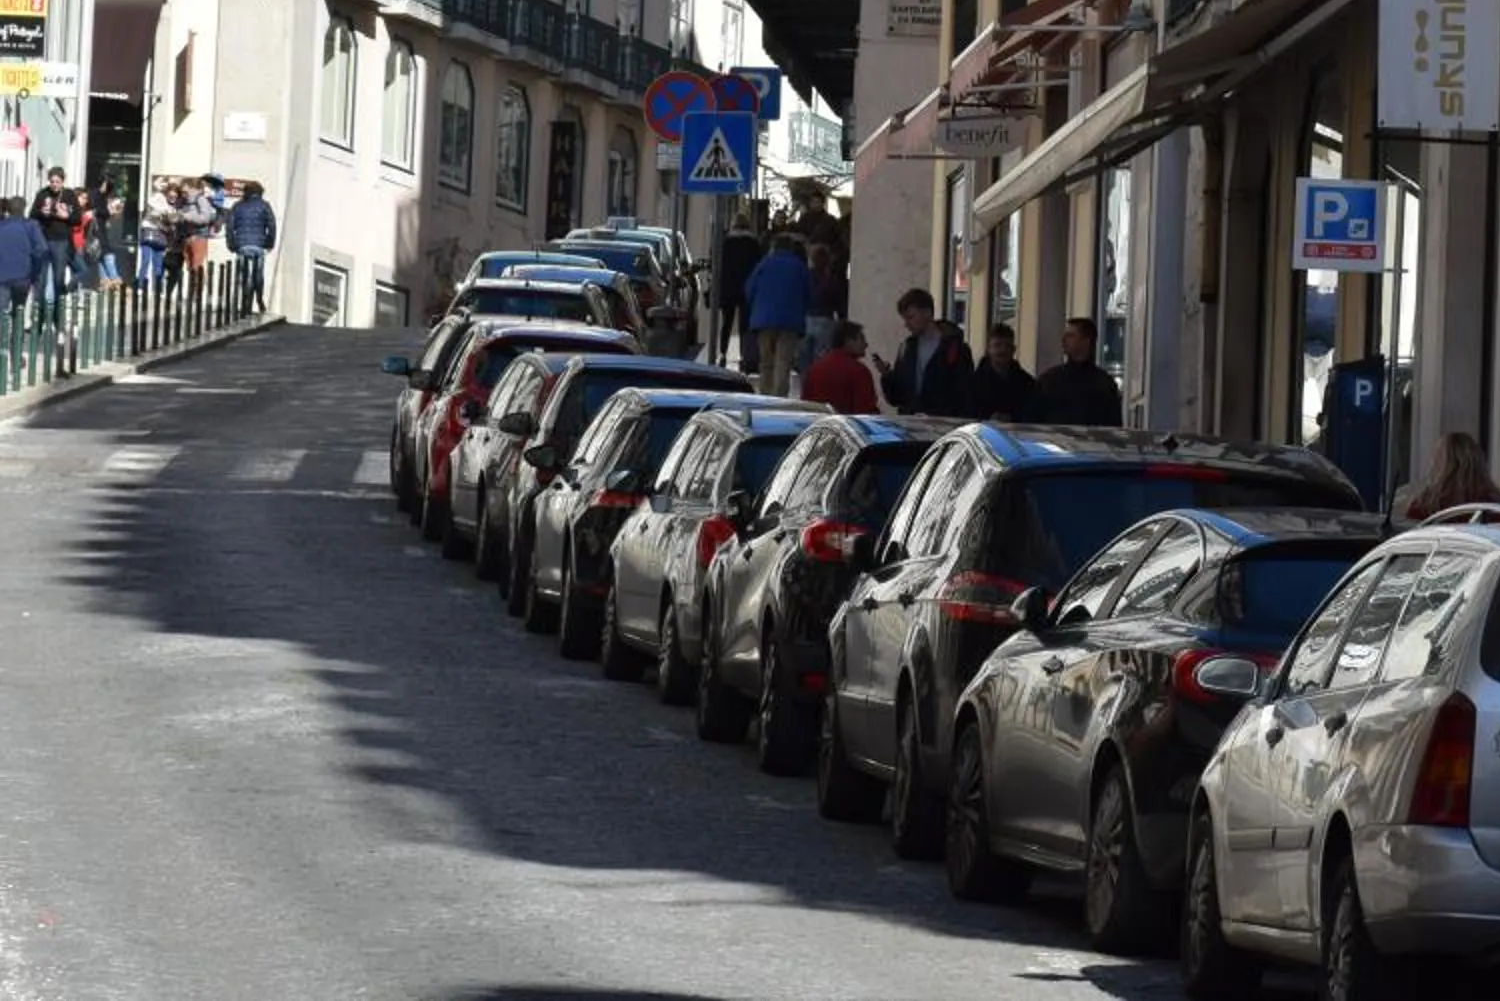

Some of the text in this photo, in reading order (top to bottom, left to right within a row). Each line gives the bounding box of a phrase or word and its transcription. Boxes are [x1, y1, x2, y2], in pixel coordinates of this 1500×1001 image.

[945, 127, 1010, 146] benefit
[1313, 191, 1349, 238] P
[1355, 379, 1373, 407] P
